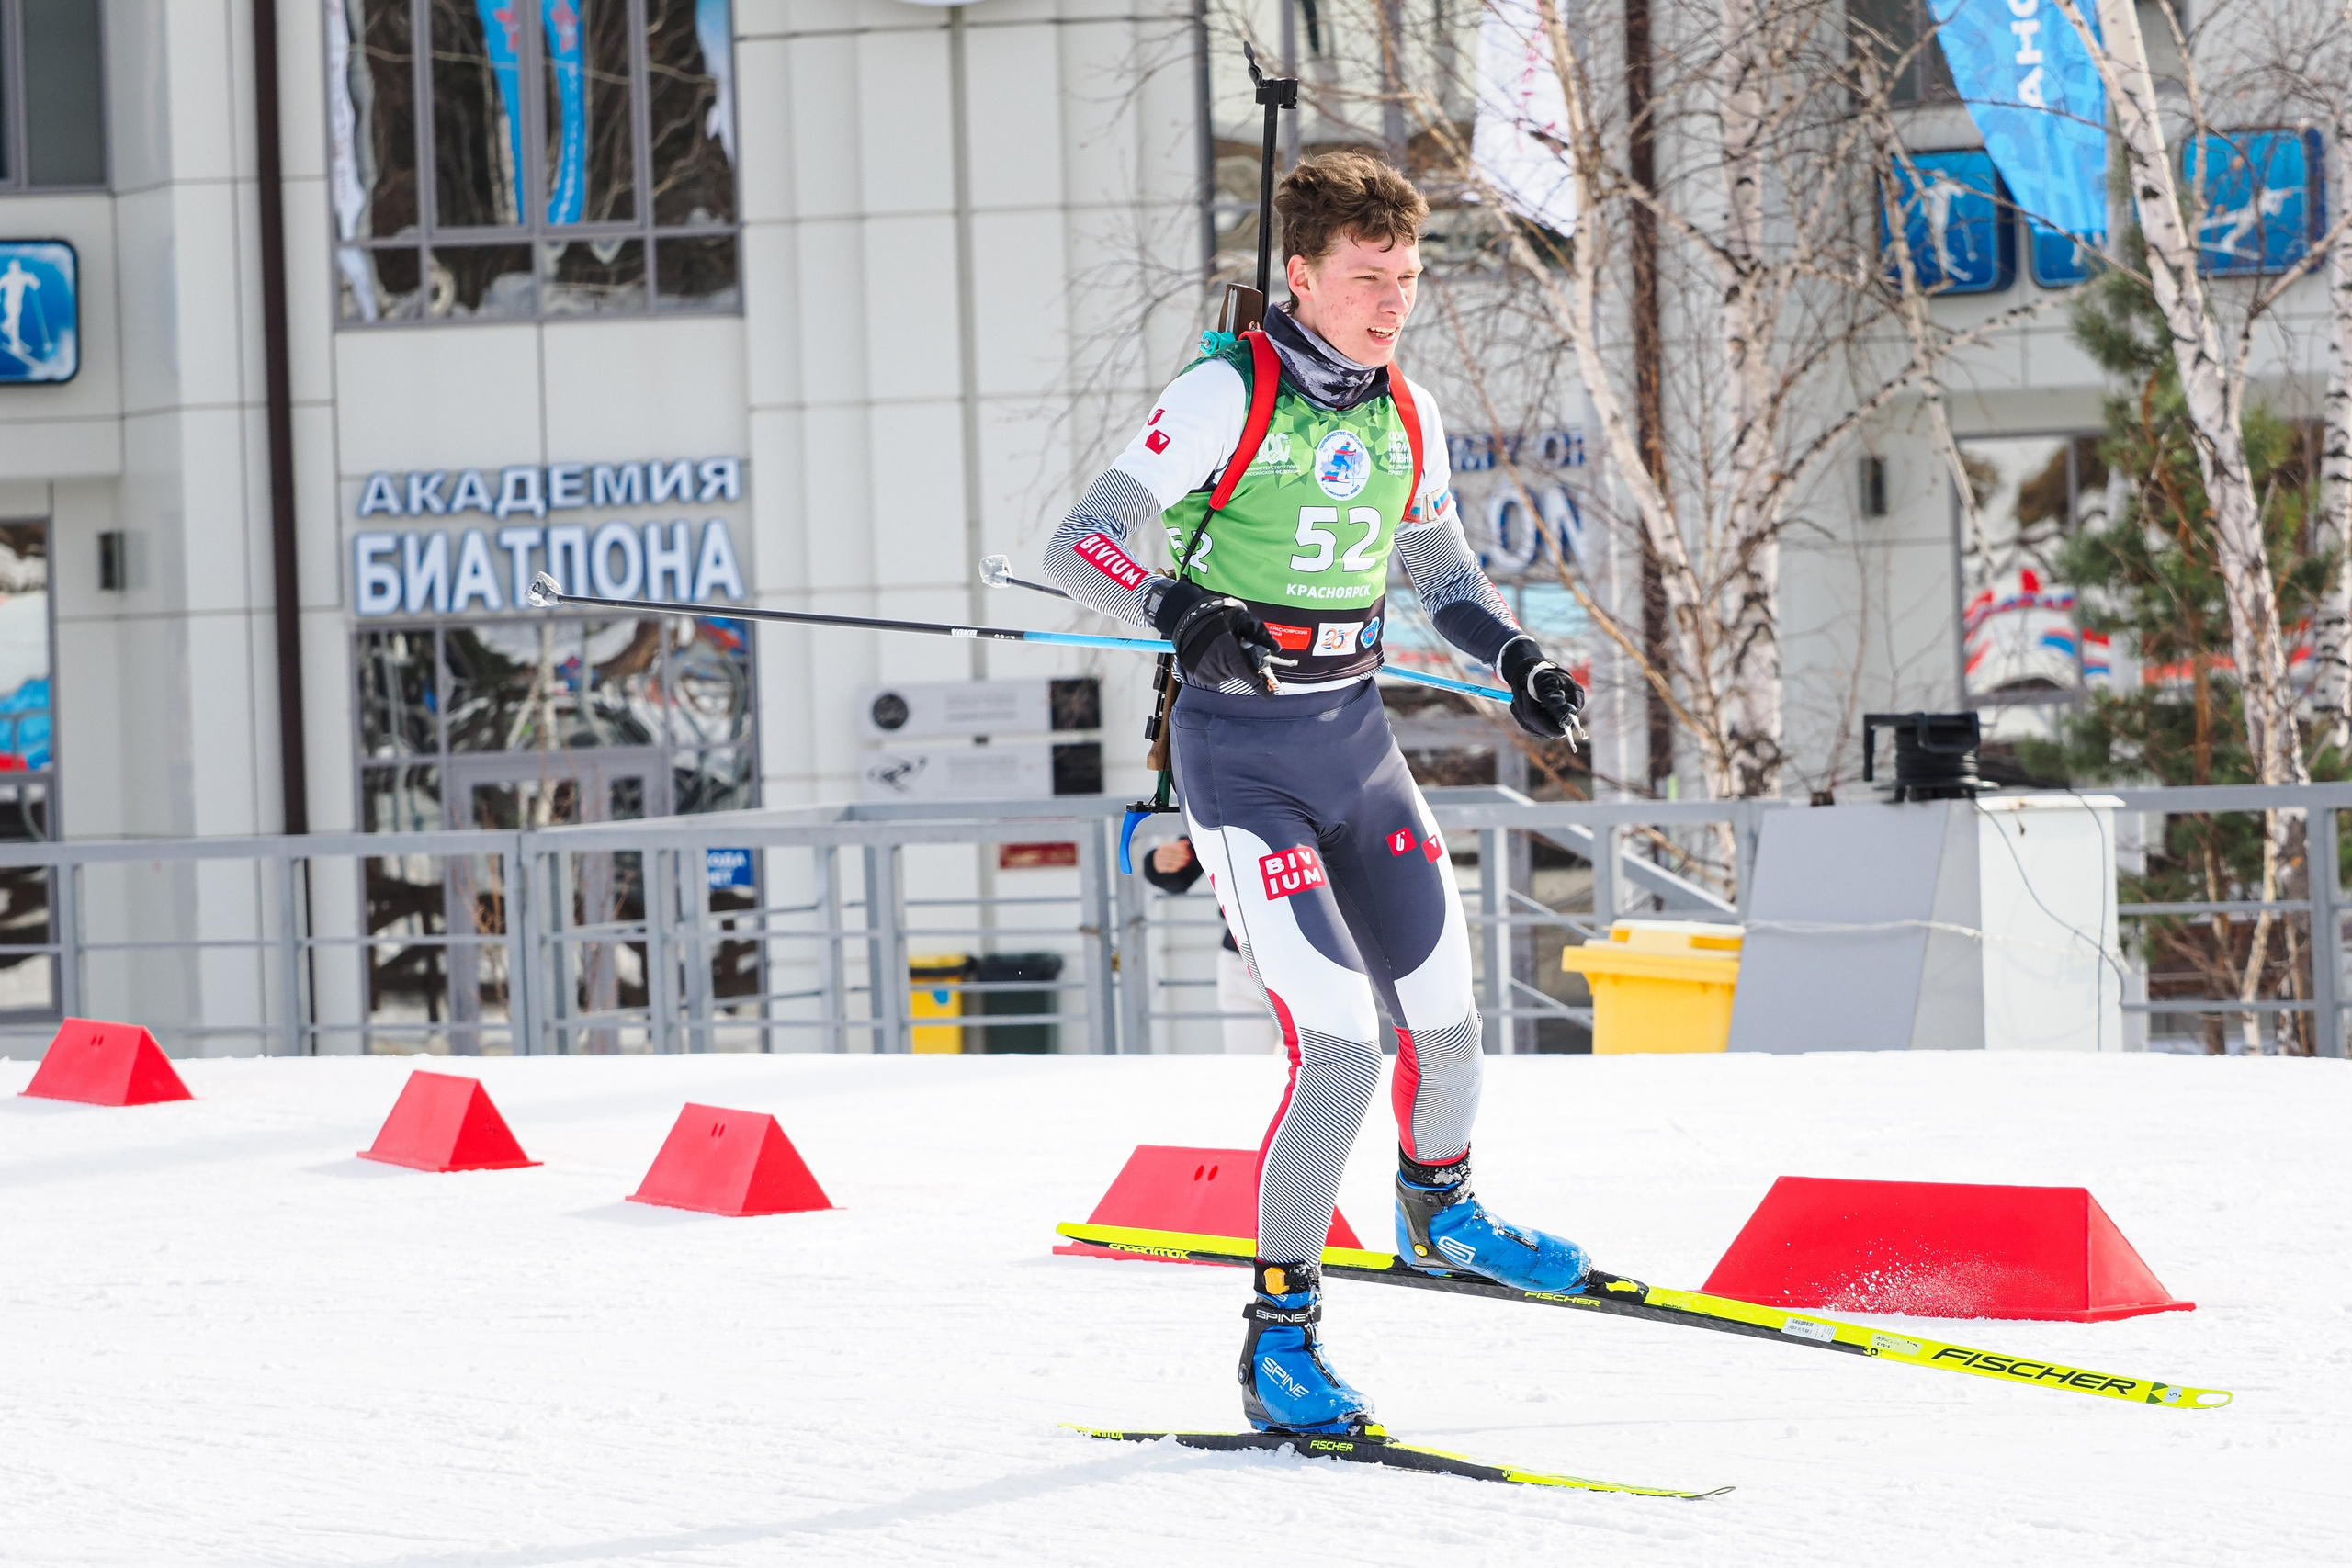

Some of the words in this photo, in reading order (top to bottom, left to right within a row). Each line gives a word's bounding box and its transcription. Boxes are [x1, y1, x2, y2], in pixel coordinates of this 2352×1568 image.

[360, 457, 741, 520] АКАДЕМИЯ
[1289, 506, 1382, 572] 52
[1079, 536, 1141, 586] BIVIUM
[1286, 583, 1372, 599] КРАСНОЯРСК
[1255, 1309, 1306, 1324] SPINE
[1524, 1291, 1601, 1307] FISCHER
[1261, 1356, 1310, 1398] SPINE
[1930, 1347, 2137, 1395] FISCHER
[1309, 1440, 1354, 1452] FISCHER
